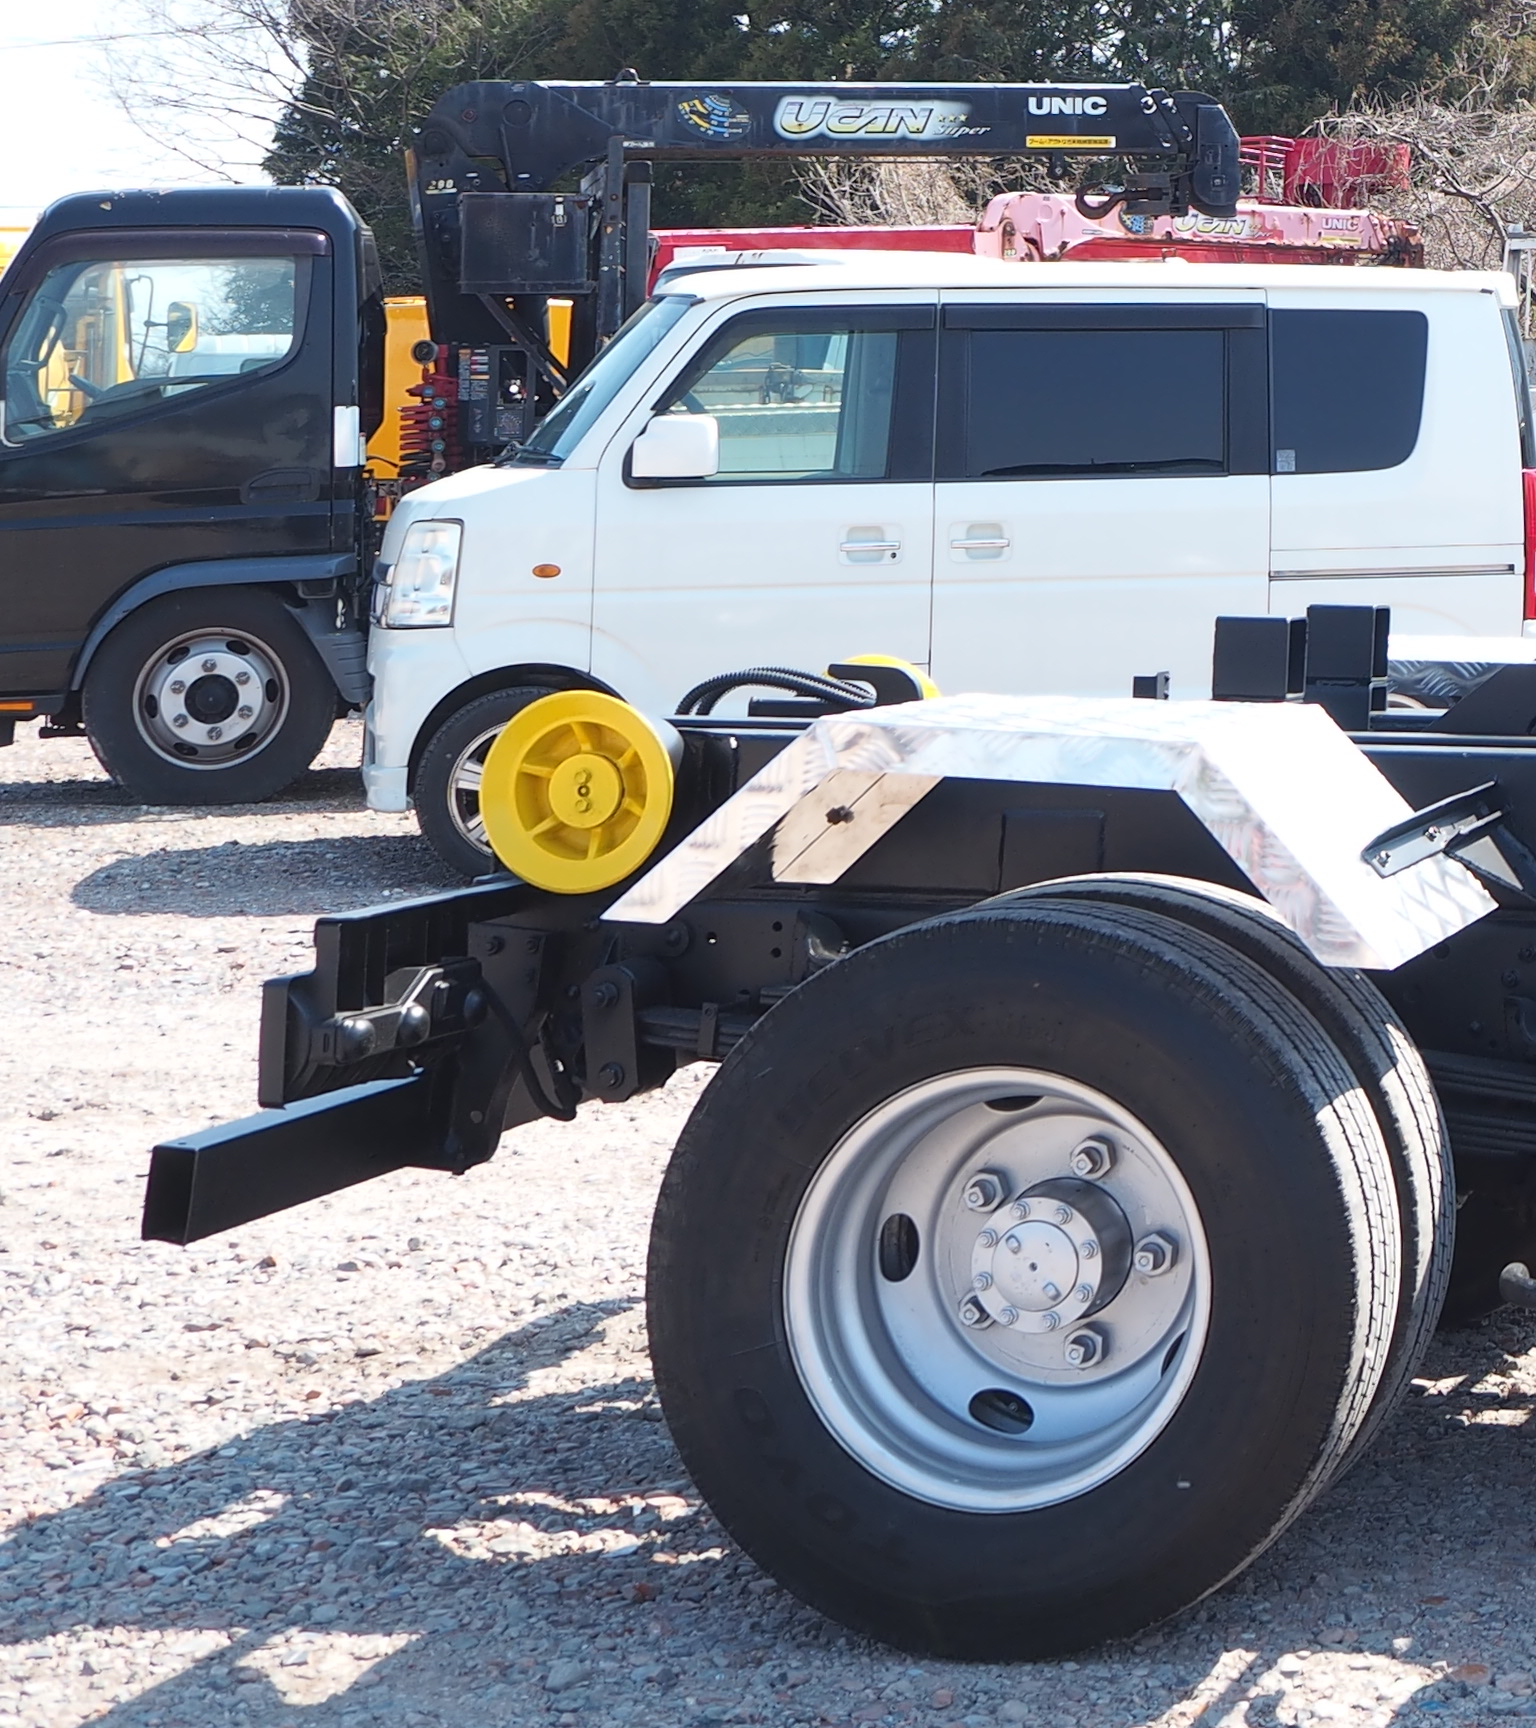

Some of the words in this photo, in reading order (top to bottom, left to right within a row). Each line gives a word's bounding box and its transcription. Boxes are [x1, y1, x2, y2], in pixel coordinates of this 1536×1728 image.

[1028, 96, 1107, 115] UNIC
[780, 101, 935, 135] UCAN
[1322, 217, 1360, 232] UNIC
